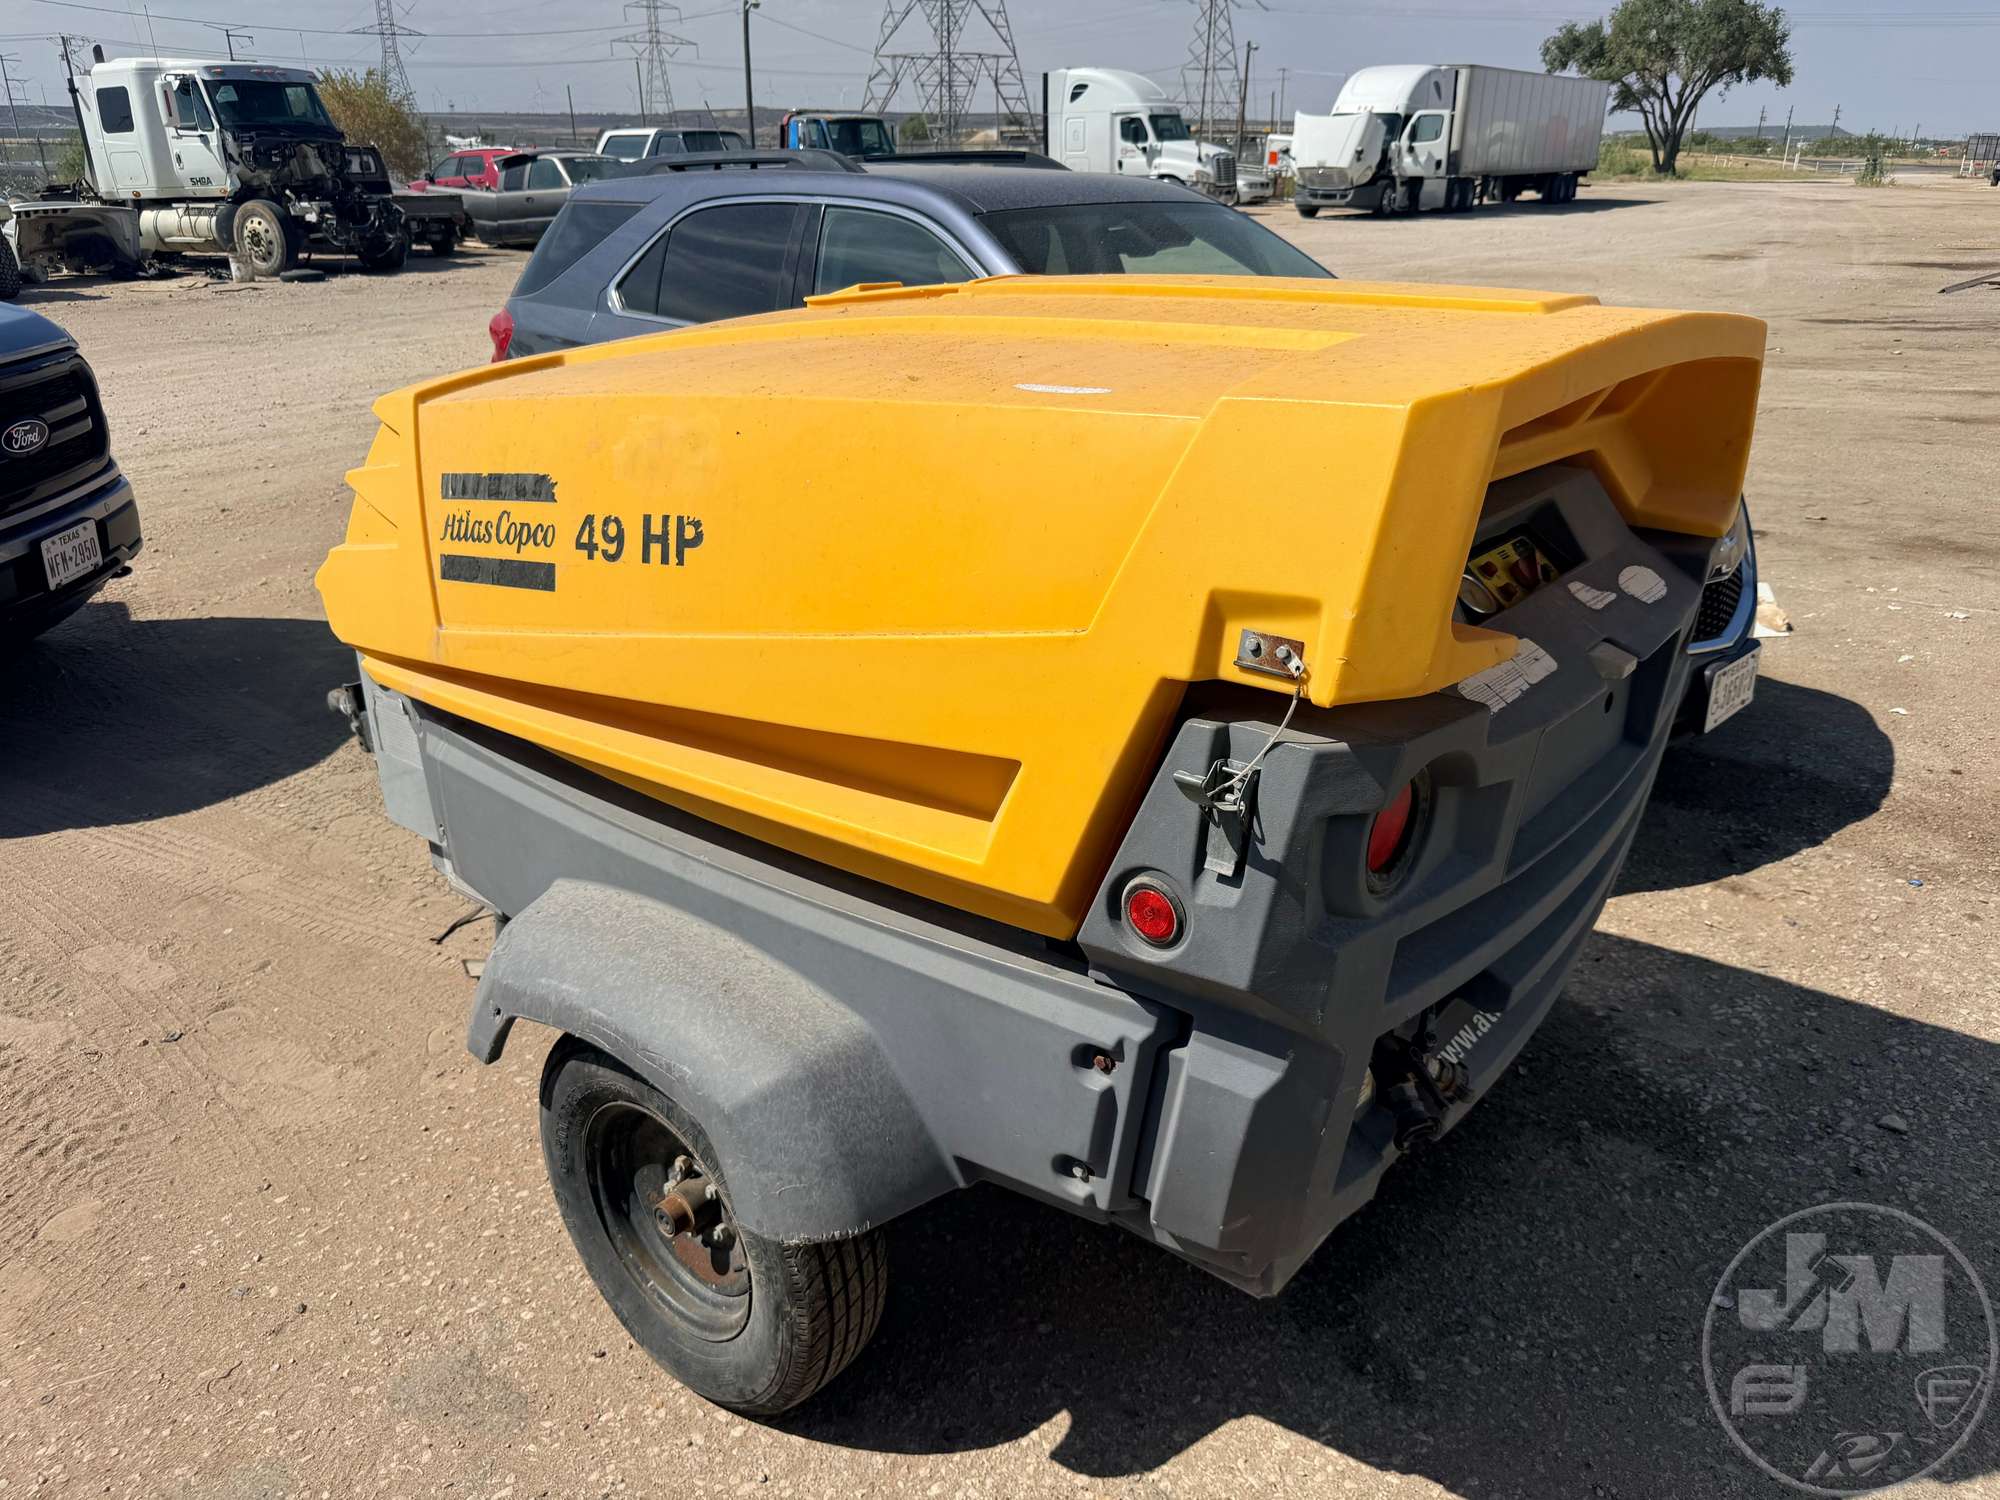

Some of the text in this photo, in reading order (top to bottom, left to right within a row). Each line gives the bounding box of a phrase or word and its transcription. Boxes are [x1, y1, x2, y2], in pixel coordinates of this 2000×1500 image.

[11, 425, 40, 448] Ford
[58, 529, 80, 546] TEXAS
[440, 509, 556, 554] Atlas Copco
[575, 513, 704, 566] 49 HP
